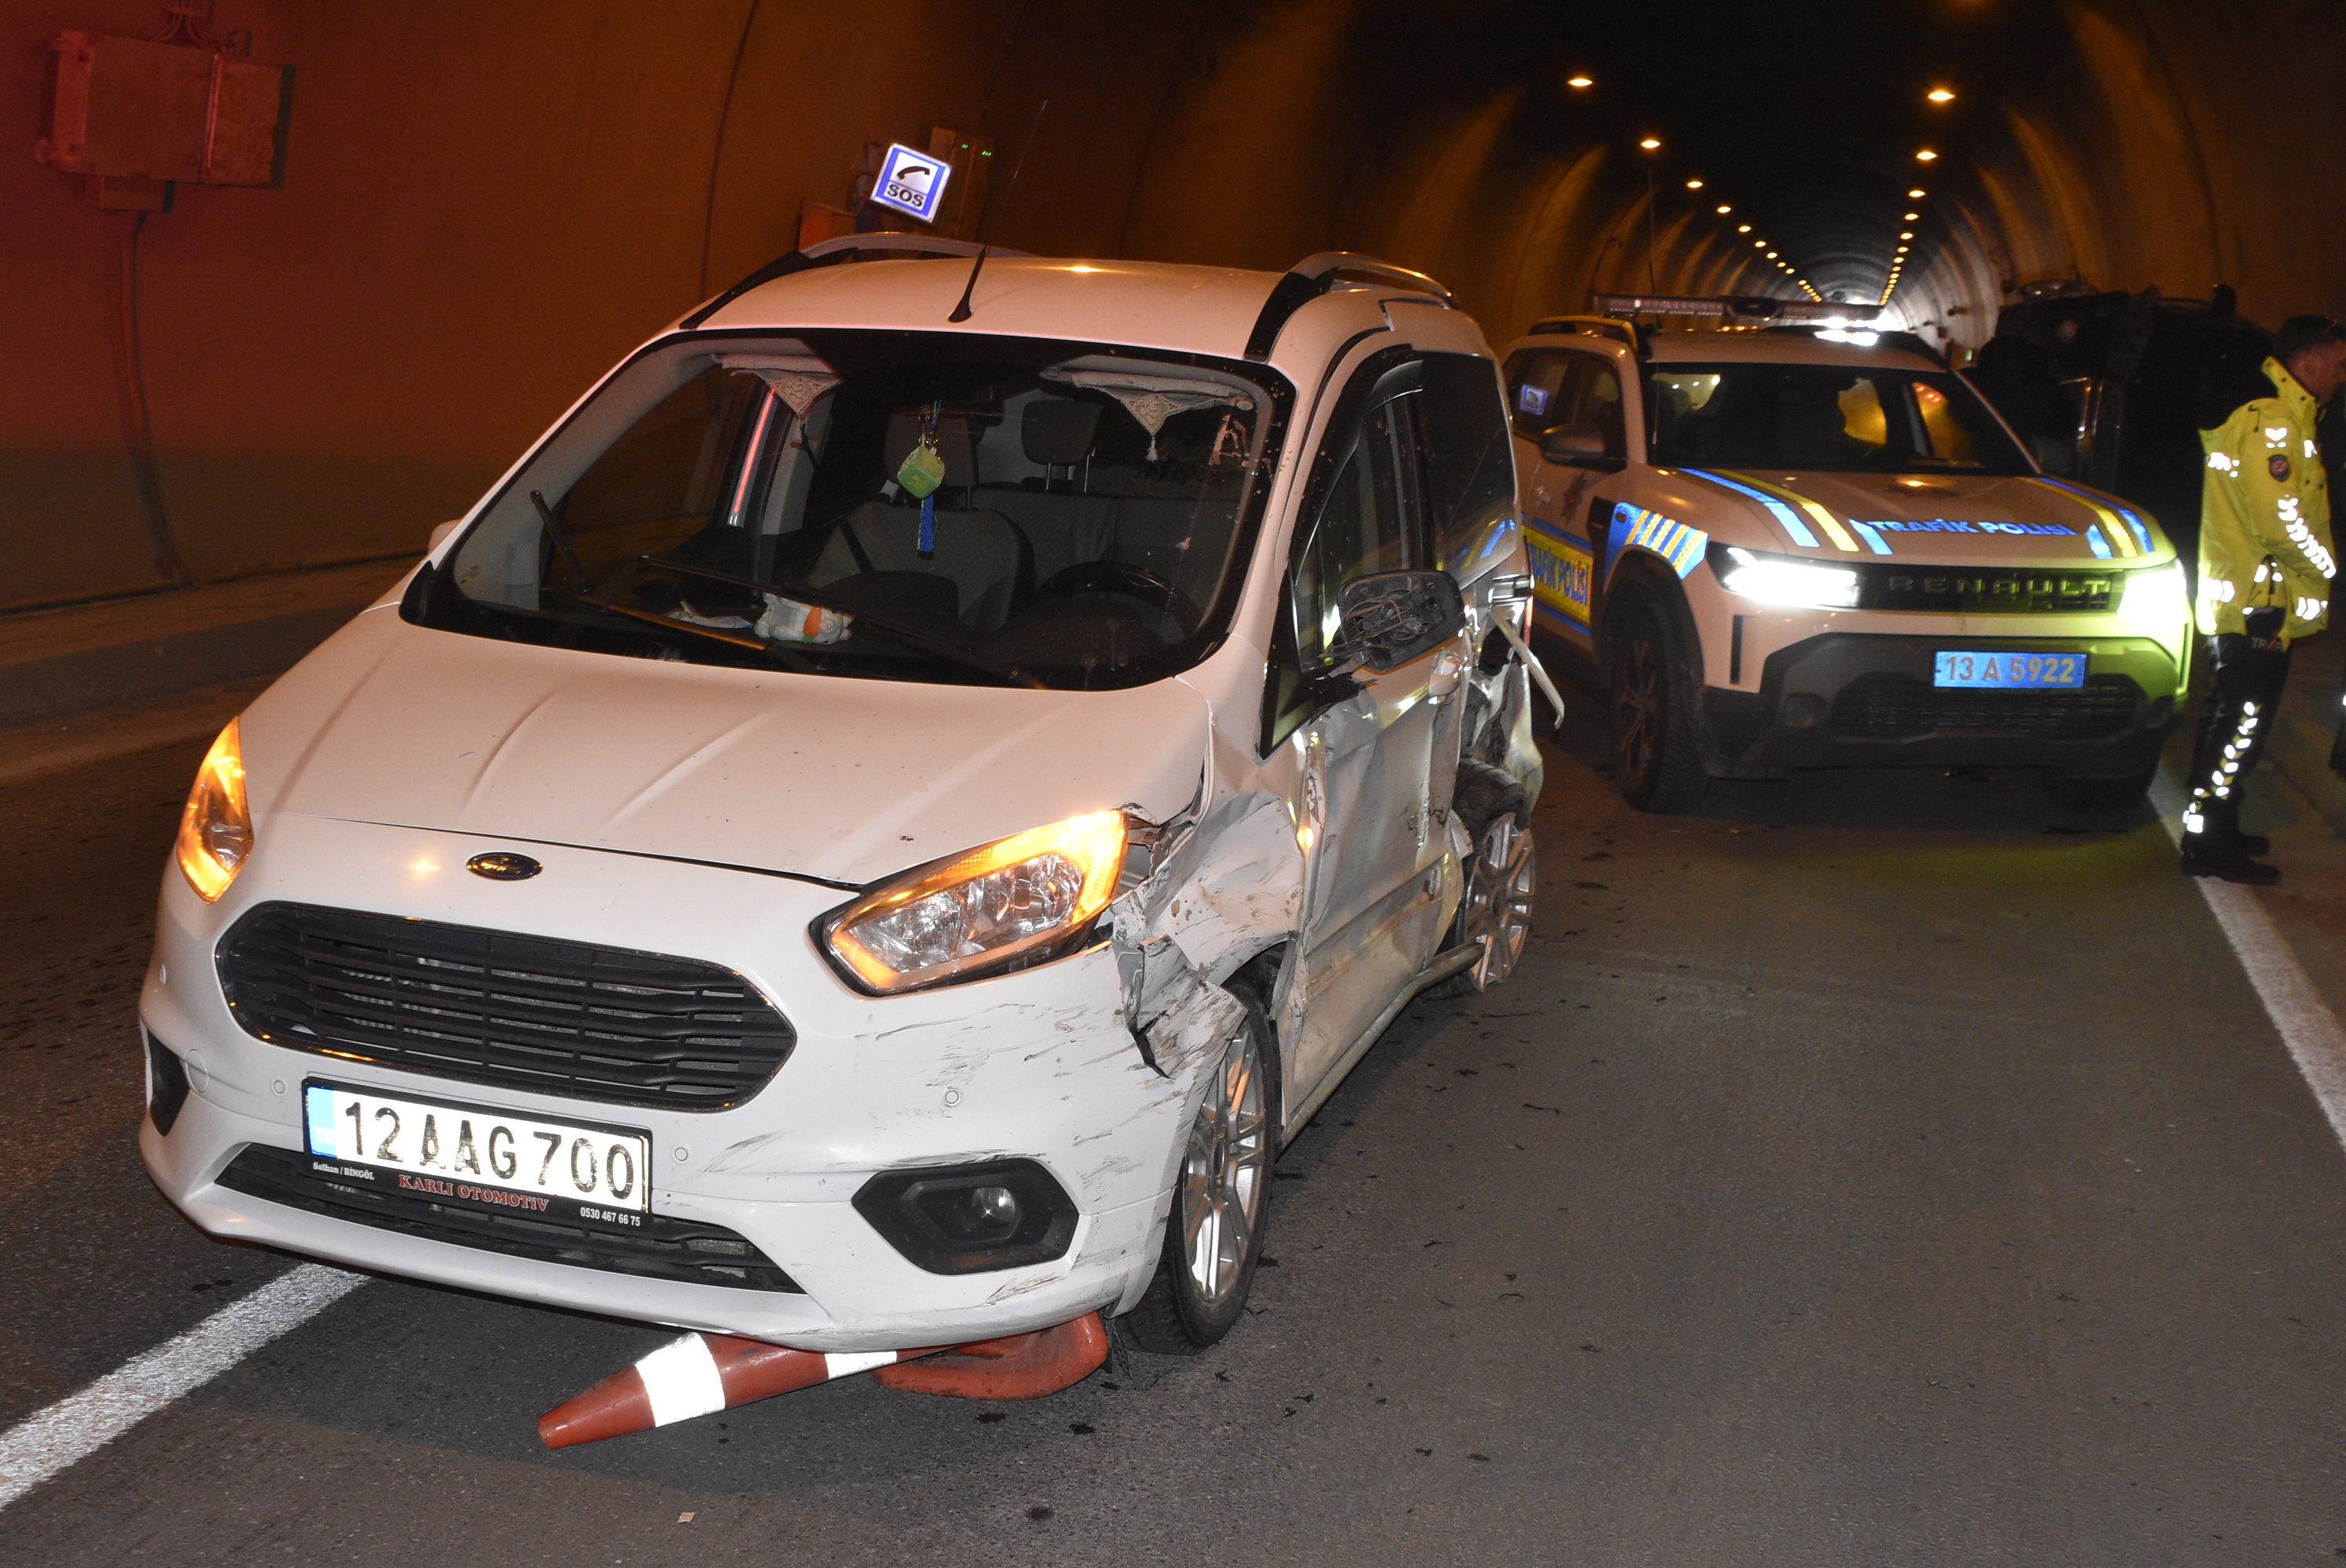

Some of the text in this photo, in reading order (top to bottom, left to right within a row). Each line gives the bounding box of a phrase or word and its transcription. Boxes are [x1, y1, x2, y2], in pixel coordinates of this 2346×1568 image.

[887, 184, 924, 207] SOS
[1867, 518, 1980, 533] TRAFİK
[1890, 576, 2110, 593] RENAULT
[1948, 656, 2075, 683] 13 A 5922
[314, 1127, 336, 1145] TR
[345, 1102, 634, 1200] 12 AAG 700
[313, 1162, 339, 1174] Solhan
[343, 1167, 375, 1180] BİNGÖL
[398, 1174, 453, 1196] KARLI
[580, 1207, 641, 1227] 0530 467 66 75
